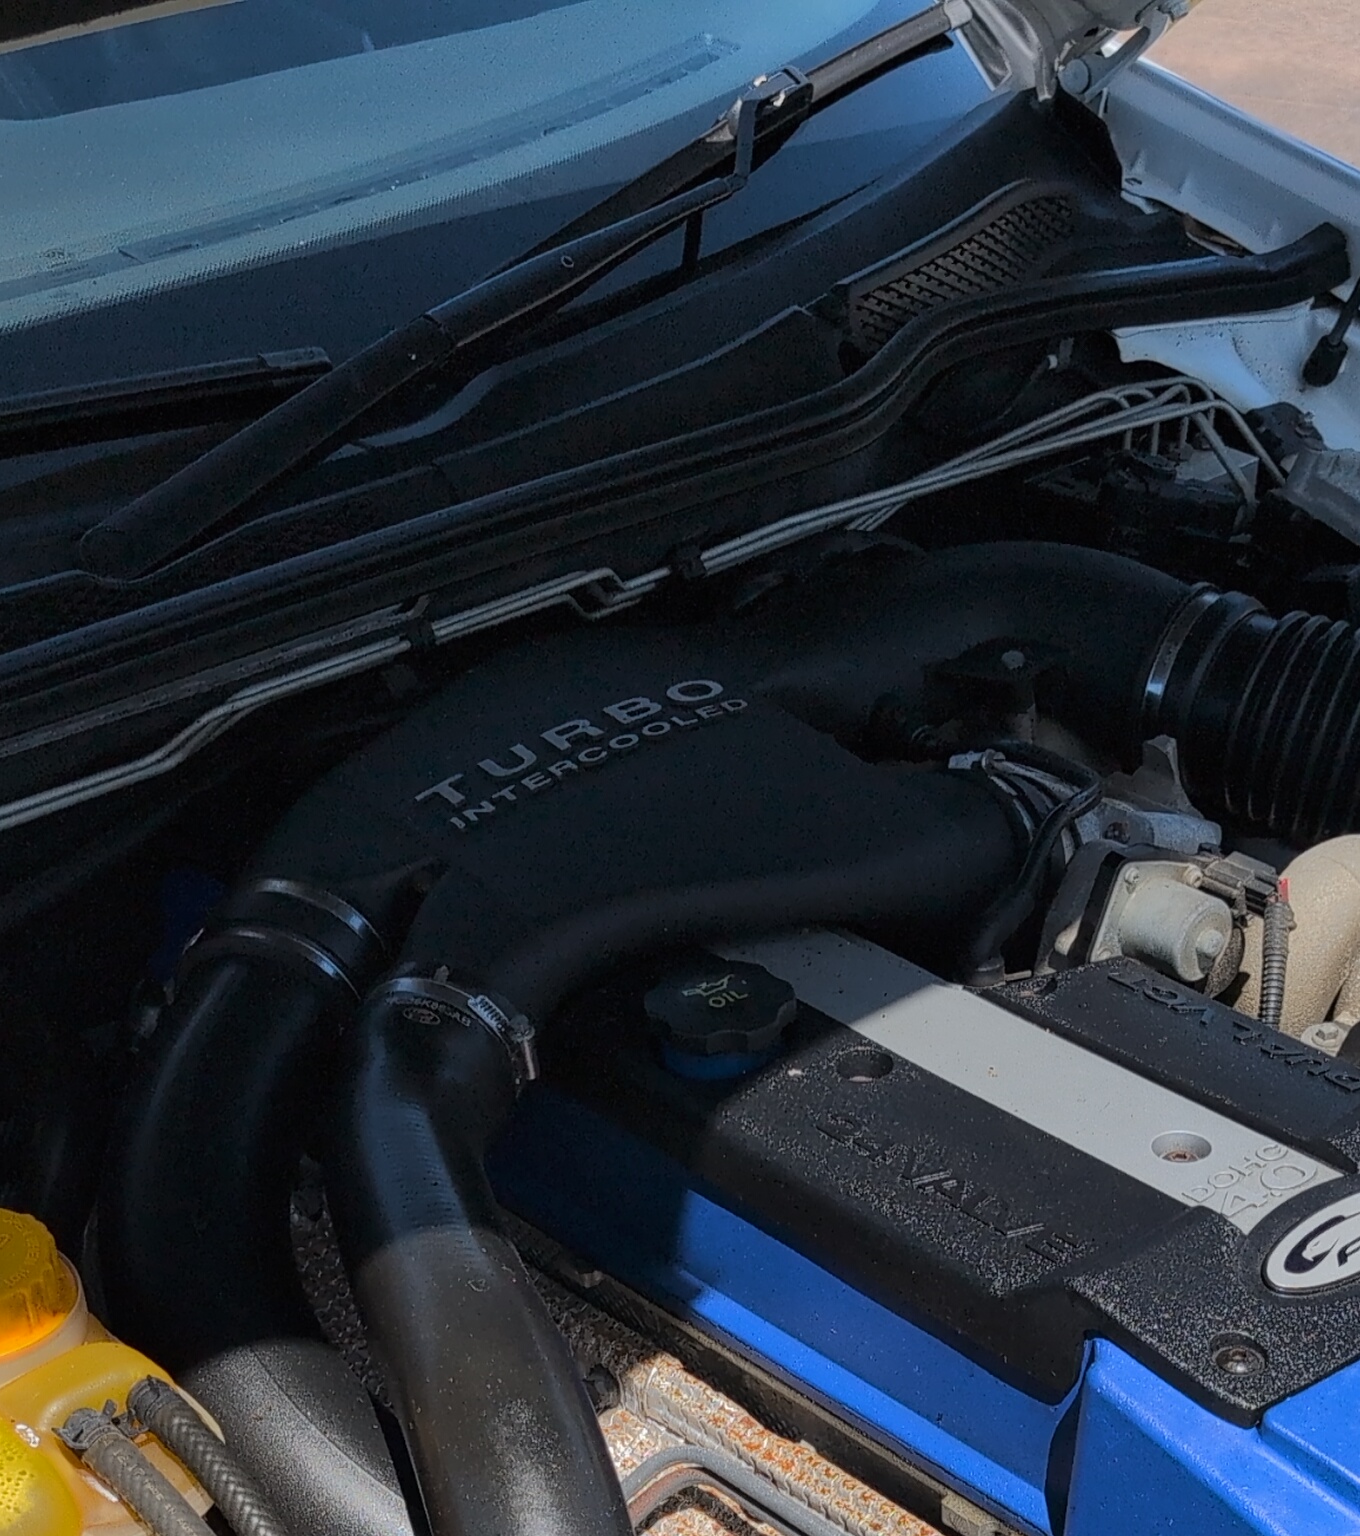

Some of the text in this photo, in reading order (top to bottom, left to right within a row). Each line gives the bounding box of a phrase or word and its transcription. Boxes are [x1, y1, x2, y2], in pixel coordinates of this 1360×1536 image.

[414, 678, 725, 807] TURBO
[448, 698, 749, 830] INTERCOOLED
[707, 988, 749, 1008] OIL
[1179, 1142, 1290, 1205] DOHC
[1217, 1158, 1317, 1223] 4.0
